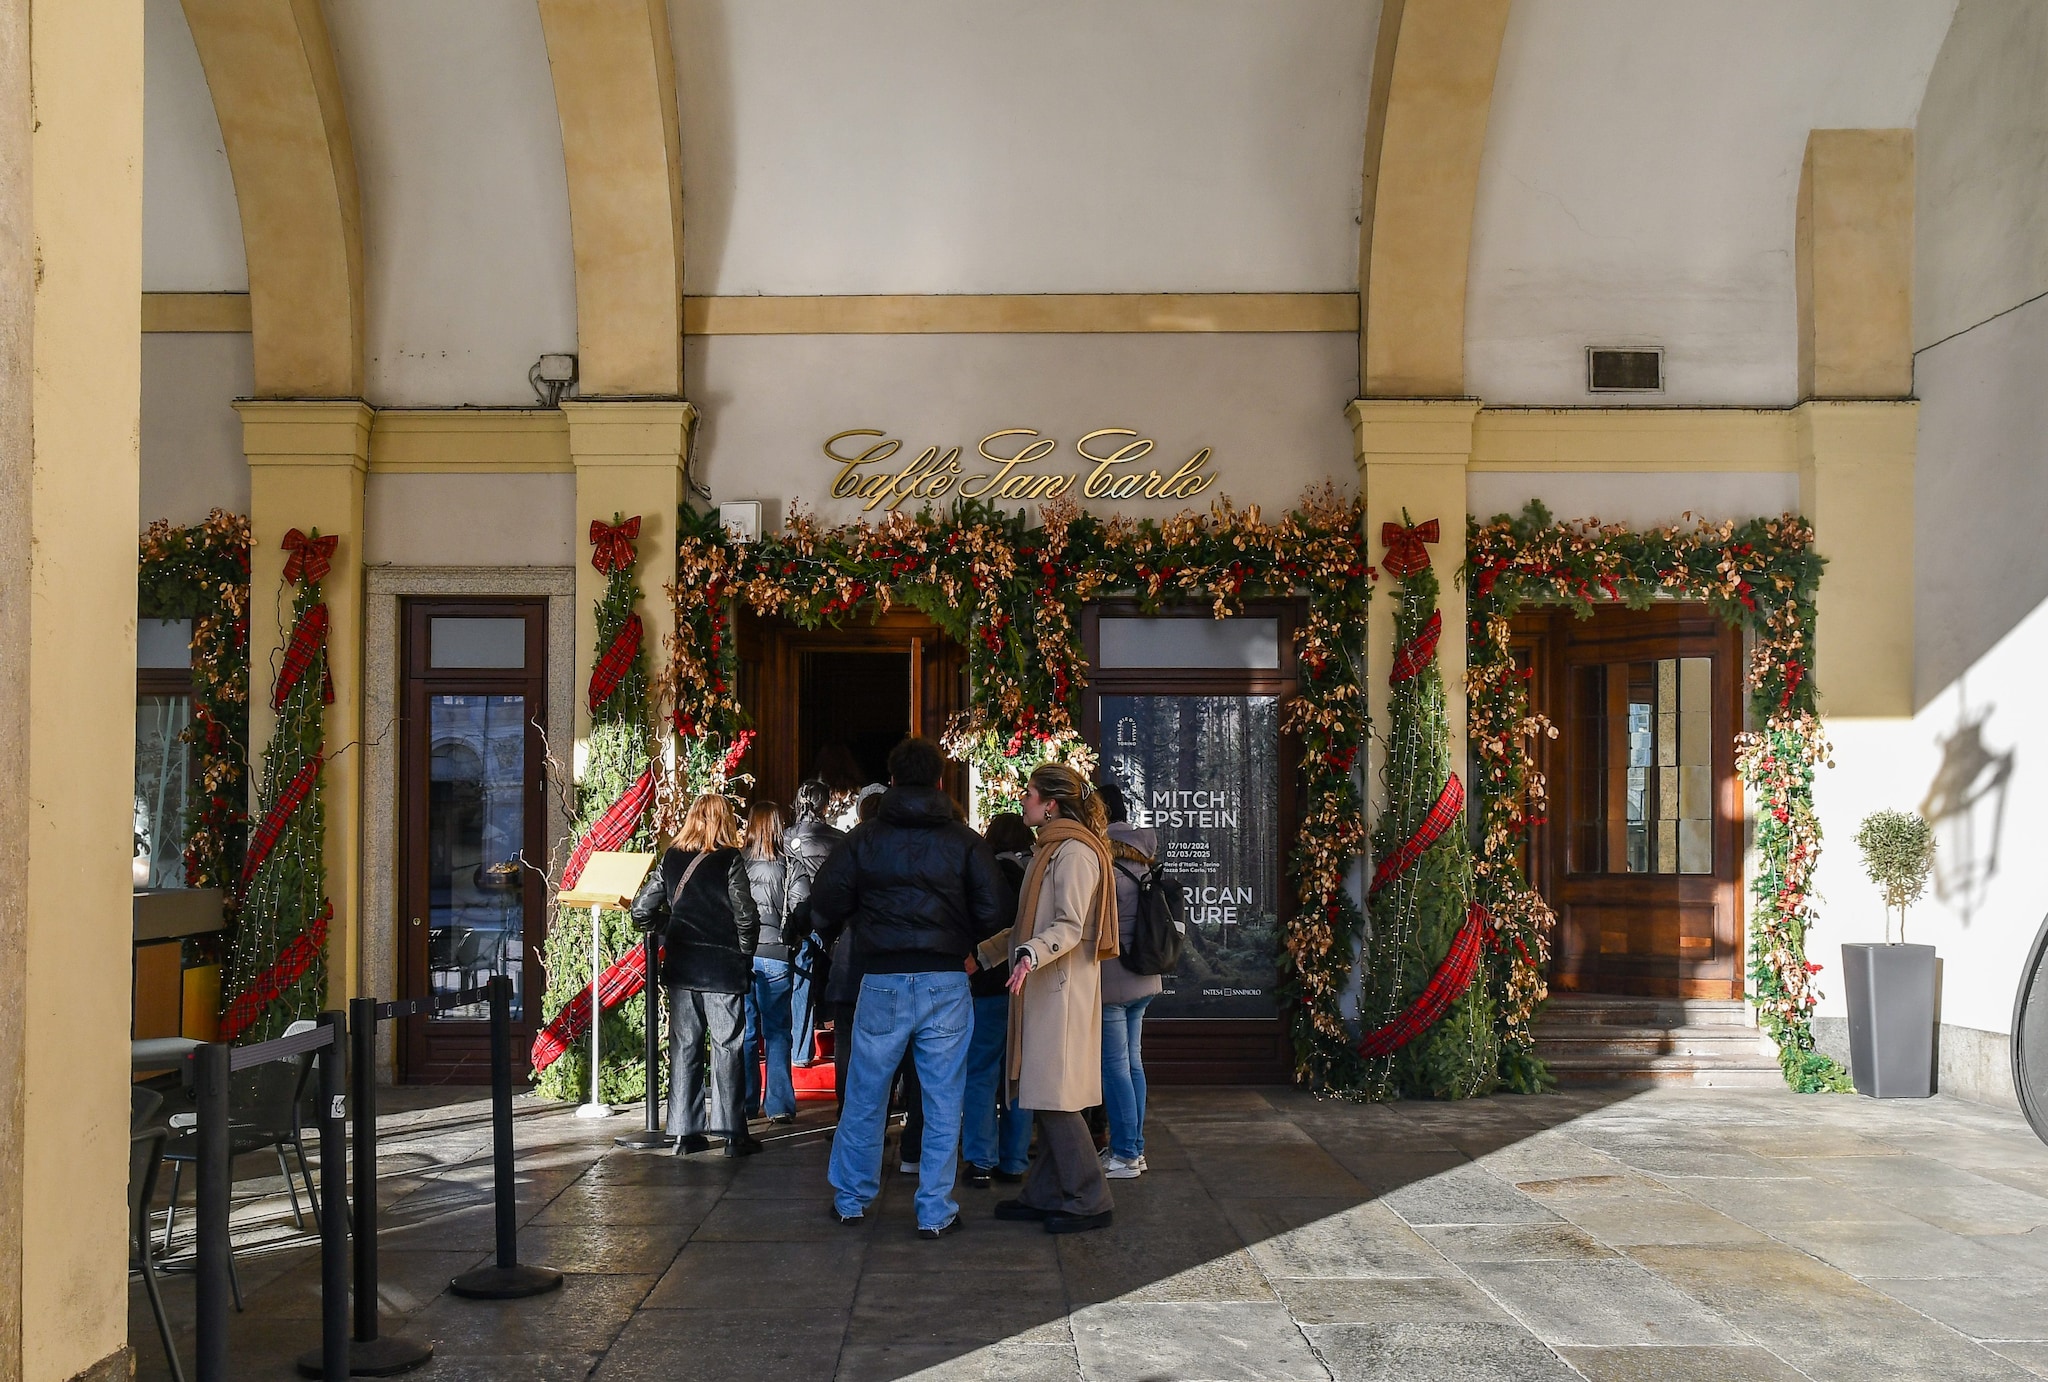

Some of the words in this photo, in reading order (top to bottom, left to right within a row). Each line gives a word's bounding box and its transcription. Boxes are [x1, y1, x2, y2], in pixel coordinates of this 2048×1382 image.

[822, 428, 962, 511] Caffè
[958, 428, 1077, 500] San
[1076, 427, 1218, 500] Carlo
[1152, 790, 1226, 809] MITCH
[1141, 810, 1237, 828] EPSTEIN
[1166, 850, 1211, 858] 02/03/2025
[1167, 842, 1210, 850] 17/10/2024
[1182, 886, 1253, 905] RICAN
[1184, 906, 1237, 924] URE
